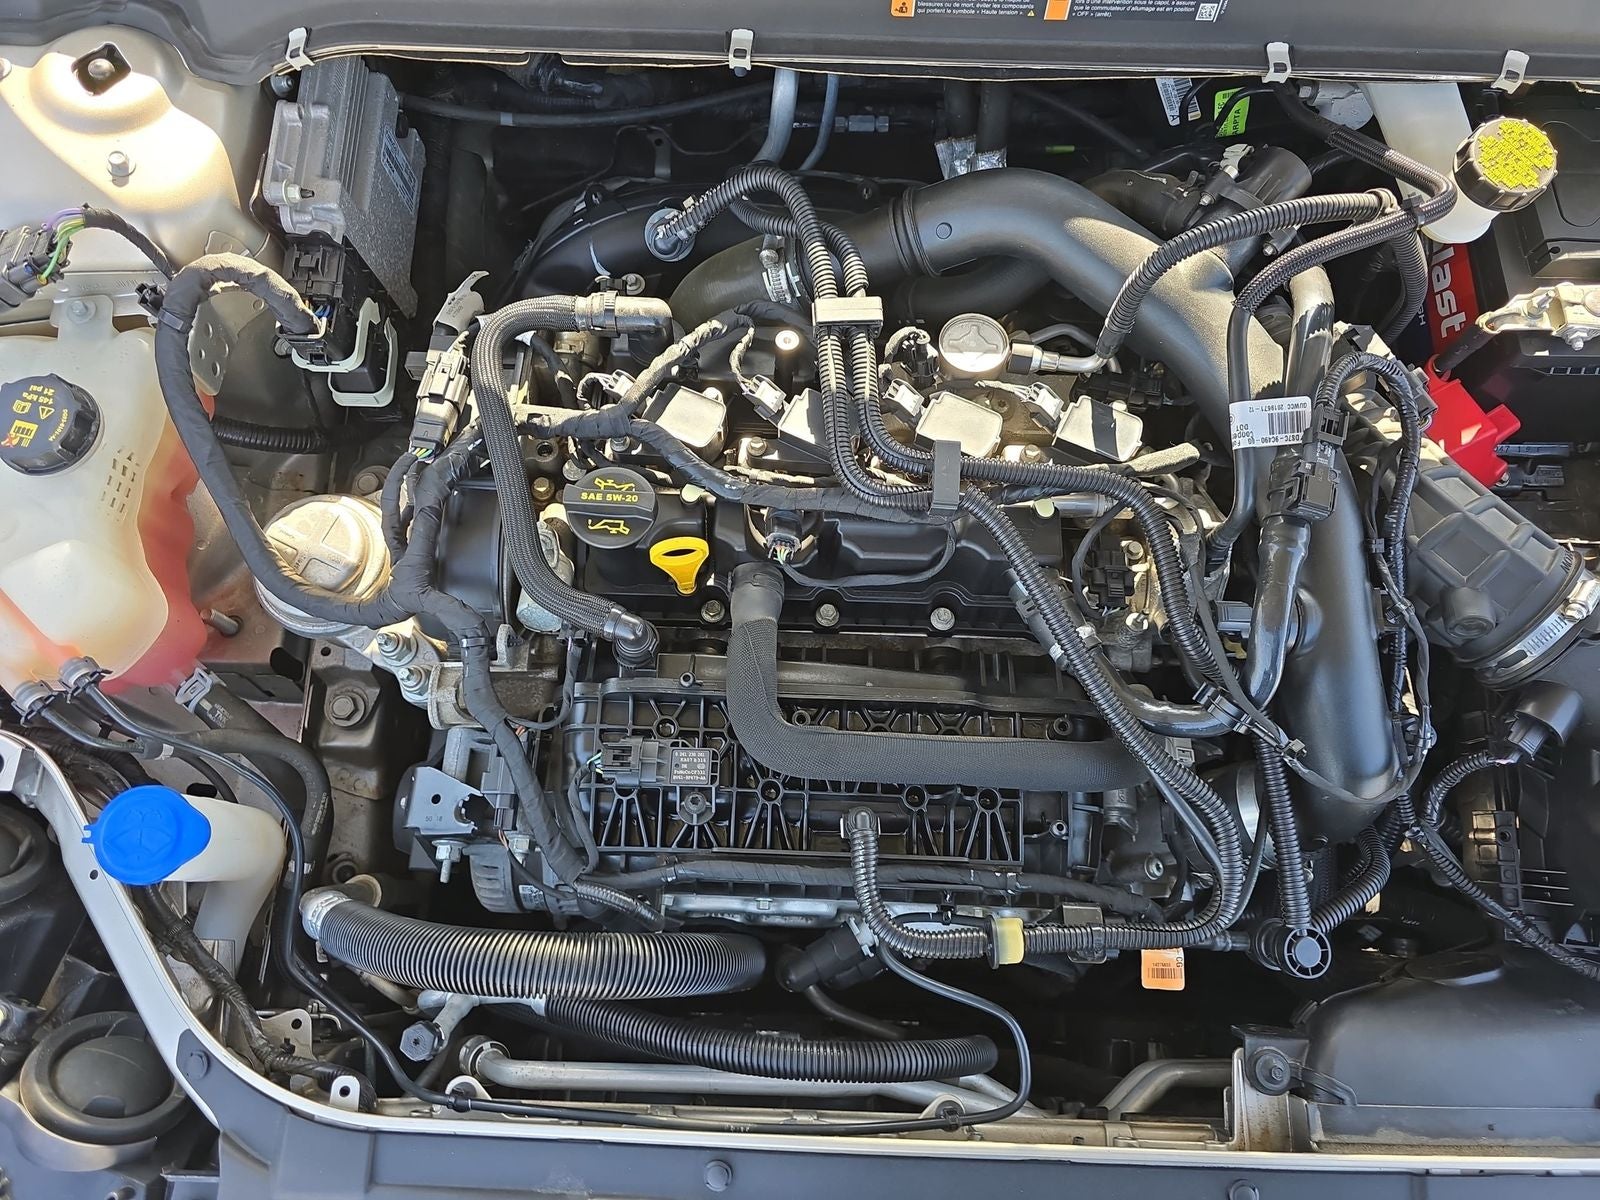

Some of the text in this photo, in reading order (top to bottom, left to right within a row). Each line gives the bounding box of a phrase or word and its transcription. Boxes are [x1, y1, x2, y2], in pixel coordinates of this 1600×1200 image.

[1431, 244, 1467, 338] last
[28, 384, 55, 396] 21 psi
[22, 391, 54, 405] 145 kPa
[580, 491, 639, 503] SAE 5W-20
[1175, 956, 1184, 968] CG
